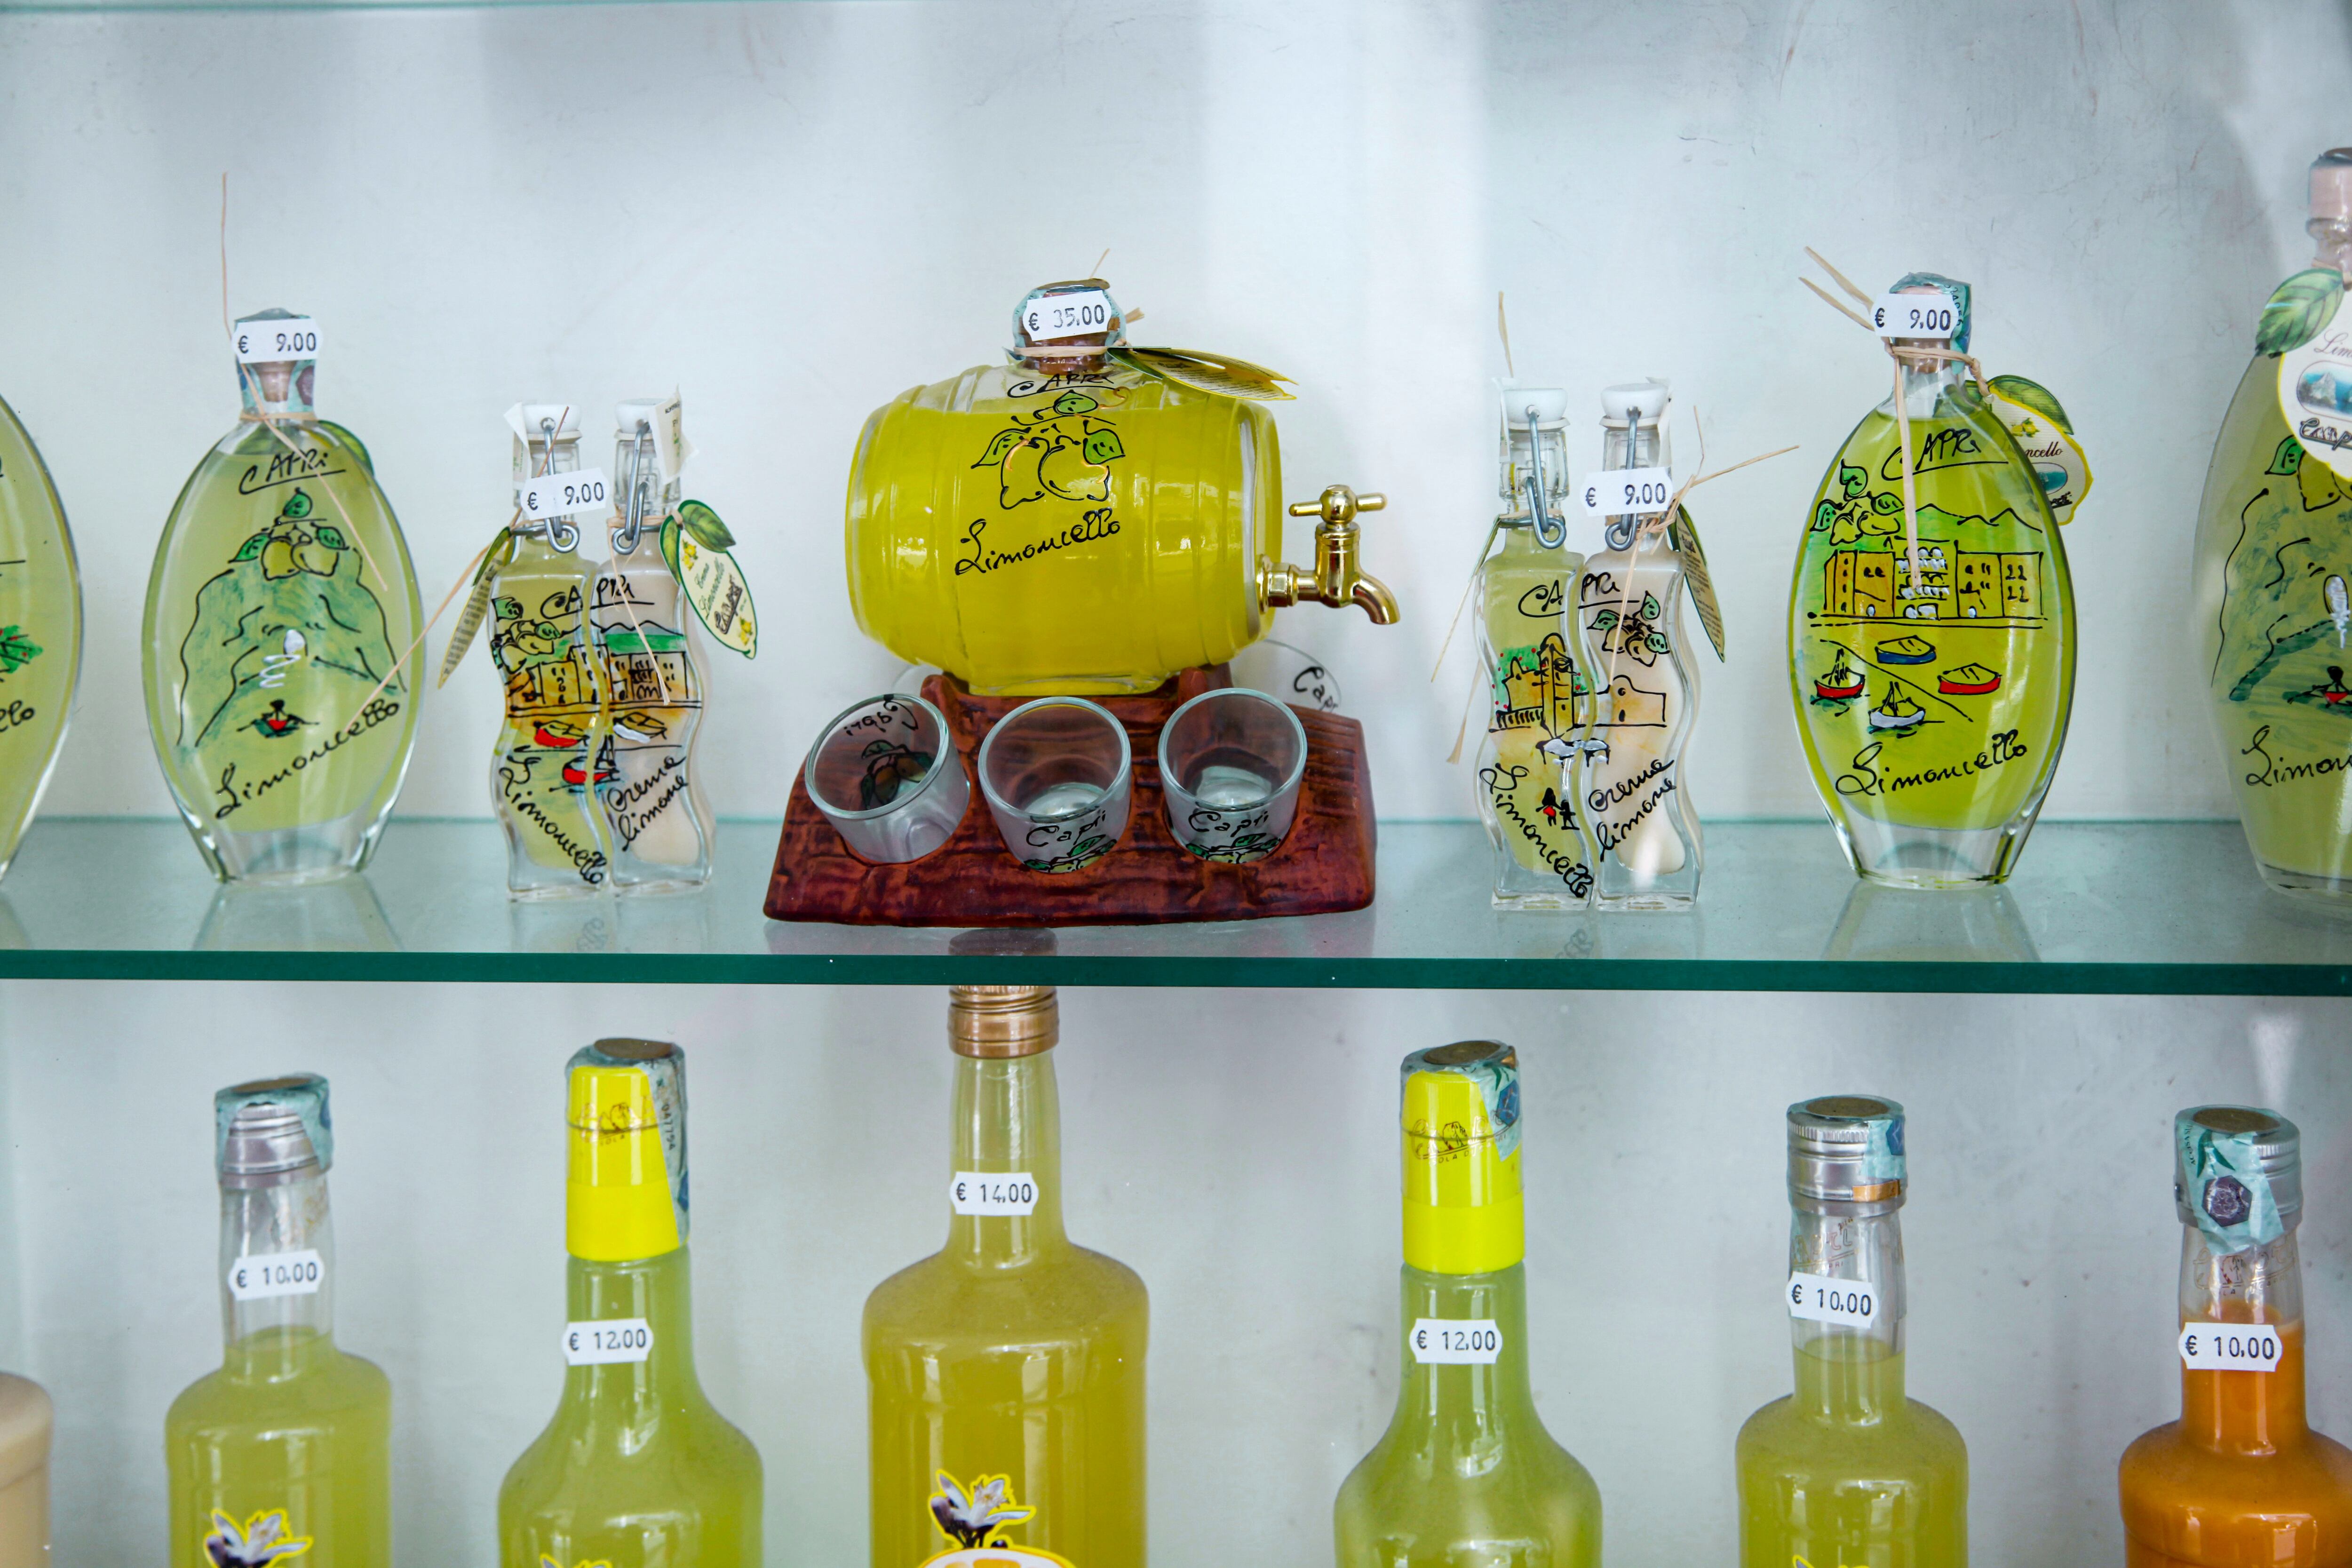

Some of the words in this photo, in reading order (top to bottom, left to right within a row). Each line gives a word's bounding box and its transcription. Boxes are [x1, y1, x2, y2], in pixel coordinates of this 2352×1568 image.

[1028, 313, 1040, 332] €
[1874, 308, 1885, 328] €
[238, 334, 249, 354] €
[2299, 417, 2352, 451] Cap
[2025, 441, 2063, 458] ncello
[527, 492, 538, 511] €
[1585, 487, 1597, 508] €
[954, 507, 1121, 575] Limoncello
[1294, 666, 1339, 713] Capr
[215, 698, 400, 820] Limoncello
[1835, 729, 2027, 796] Limoncello
[498, 755, 607, 884] Limoncello
[618, 774, 689, 852] limone
[1188, 810, 1270, 837] Capri
[1597, 778, 1677, 862] limone
[1025, 808, 1106, 848] Capri
[1479, 762, 1594, 898] Limoncello
[955, 1184, 967, 1202] €
[236, 1270, 247, 1289] €
[1791, 1284, 1803, 1305] €
[569, 1333, 580, 1351] €
[1416, 1330, 1427, 1350] €
[2185, 1336, 2198, 1357] €
